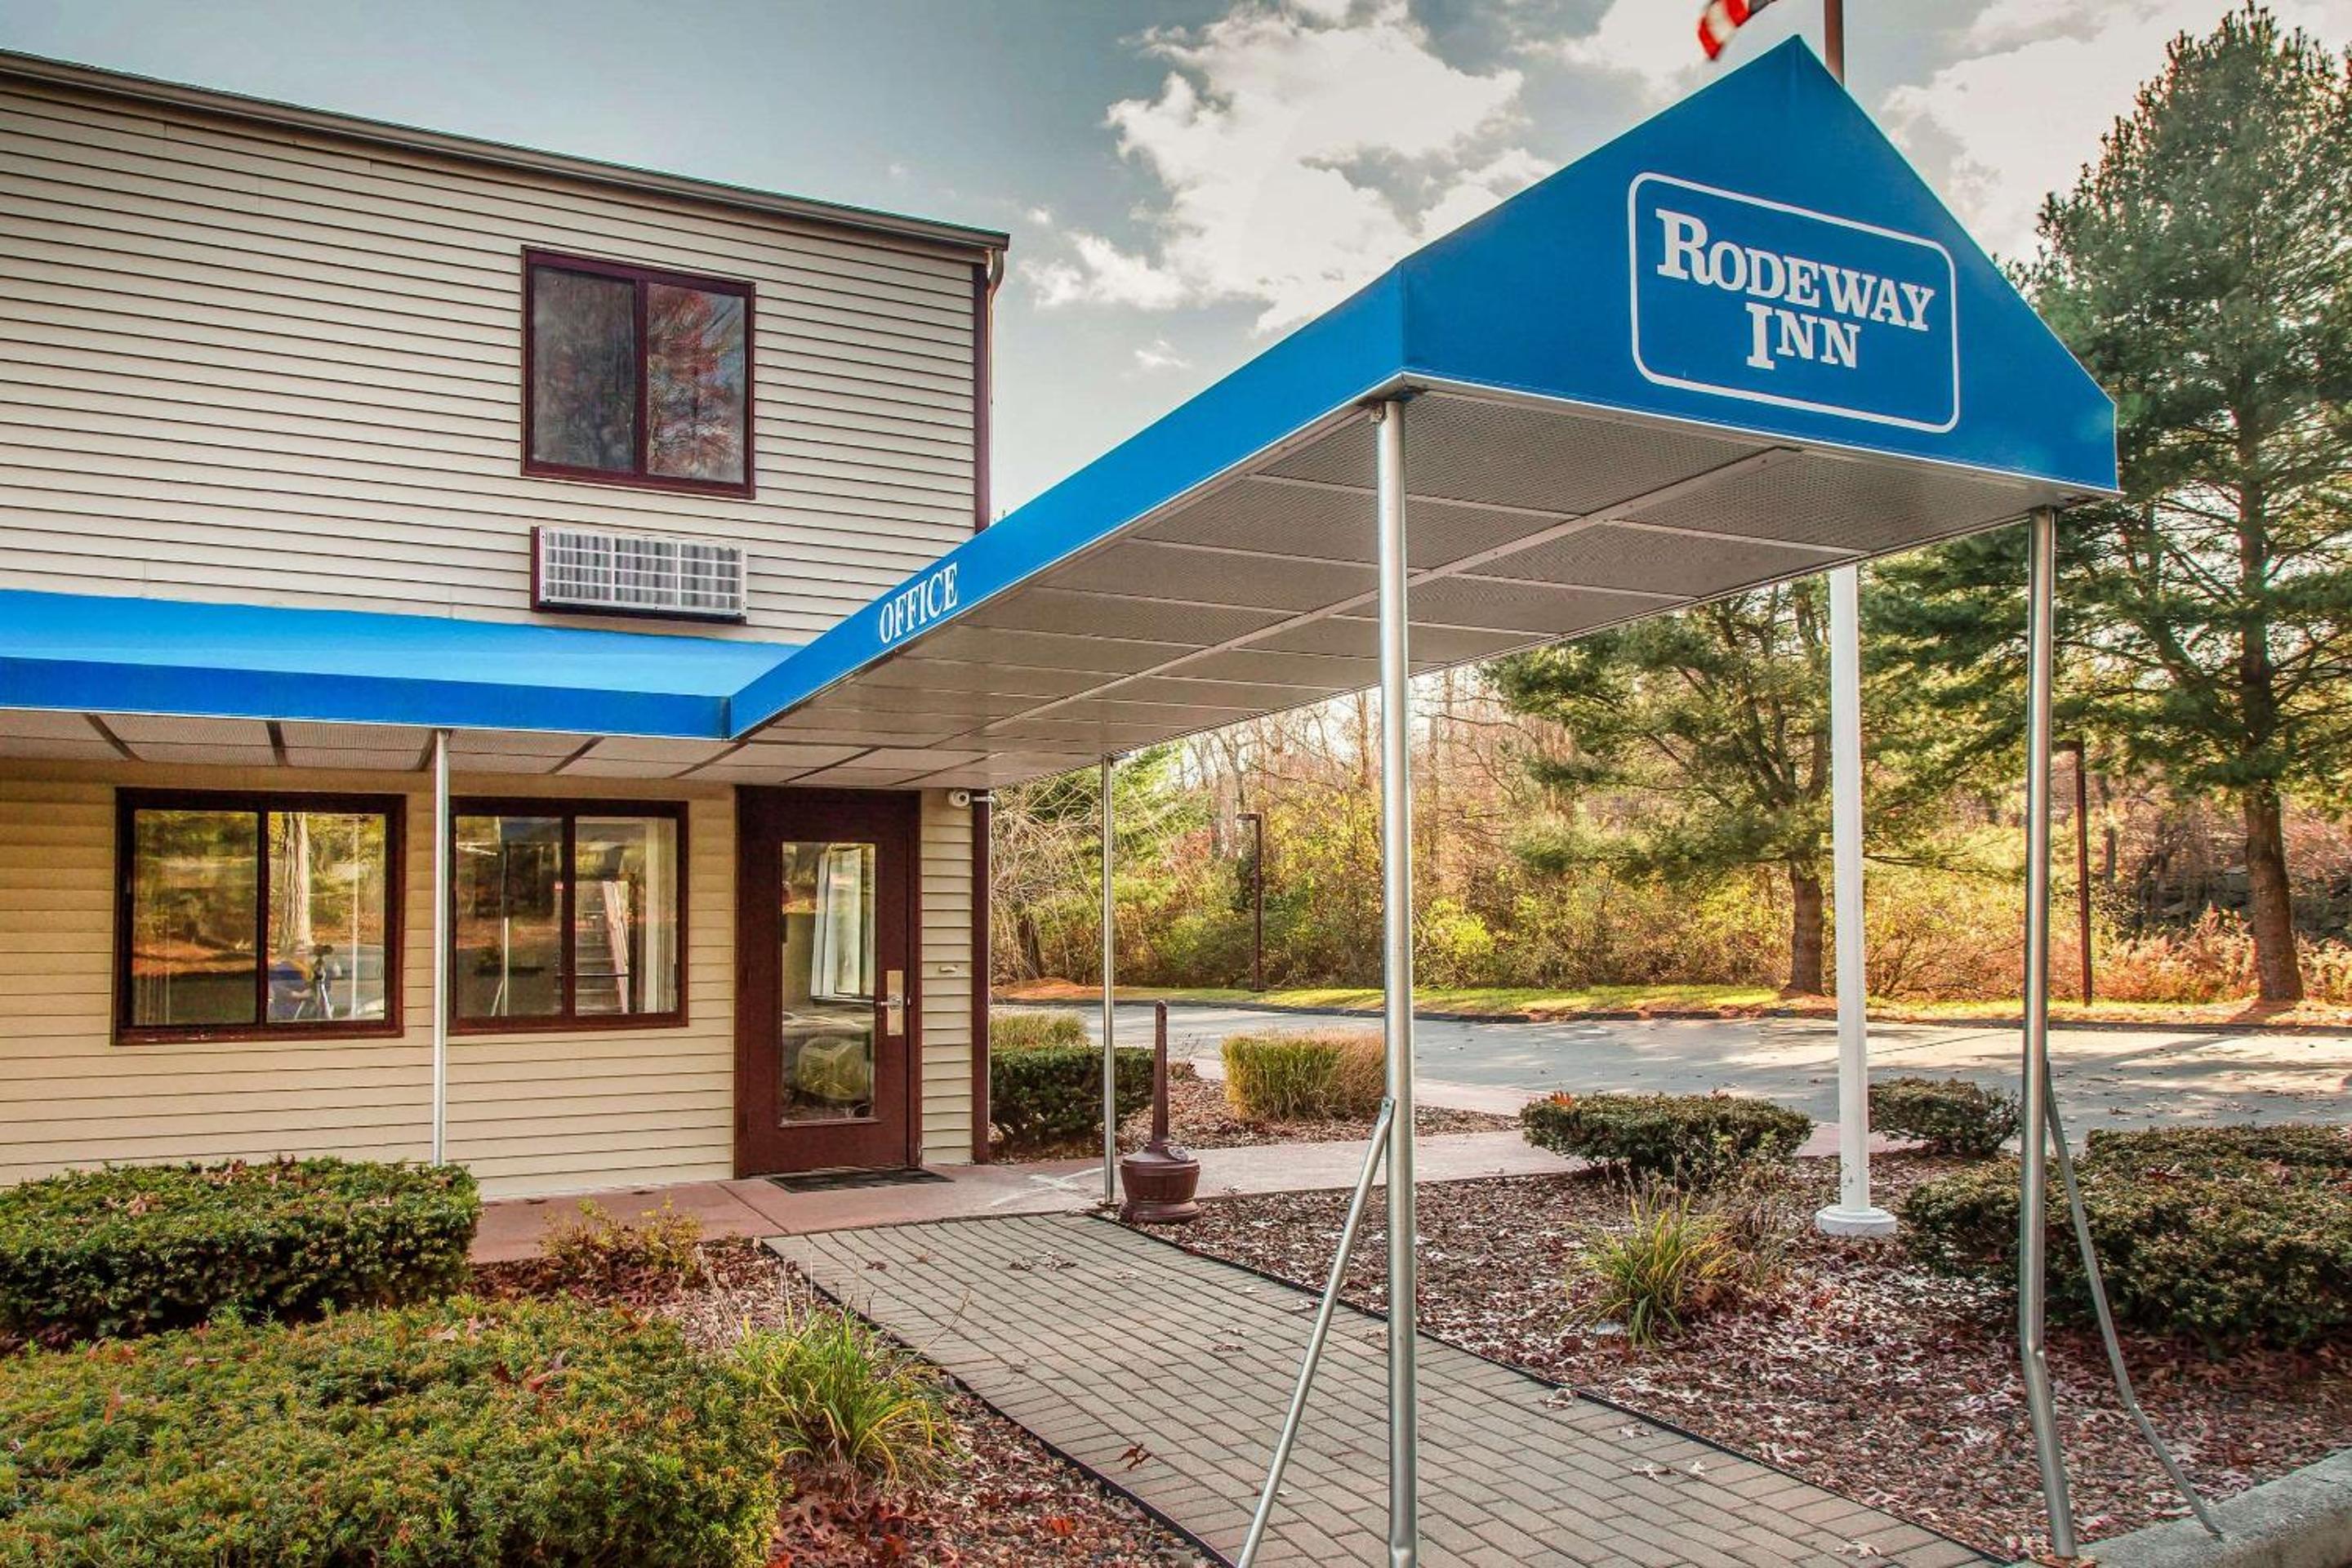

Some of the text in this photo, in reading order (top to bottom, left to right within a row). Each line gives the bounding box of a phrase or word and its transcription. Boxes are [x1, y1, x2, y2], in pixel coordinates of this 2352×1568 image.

[1655, 208, 1935, 331] RODEWAY
[1745, 302, 1860, 369] INN
[880, 562, 957, 644] OFFICE
